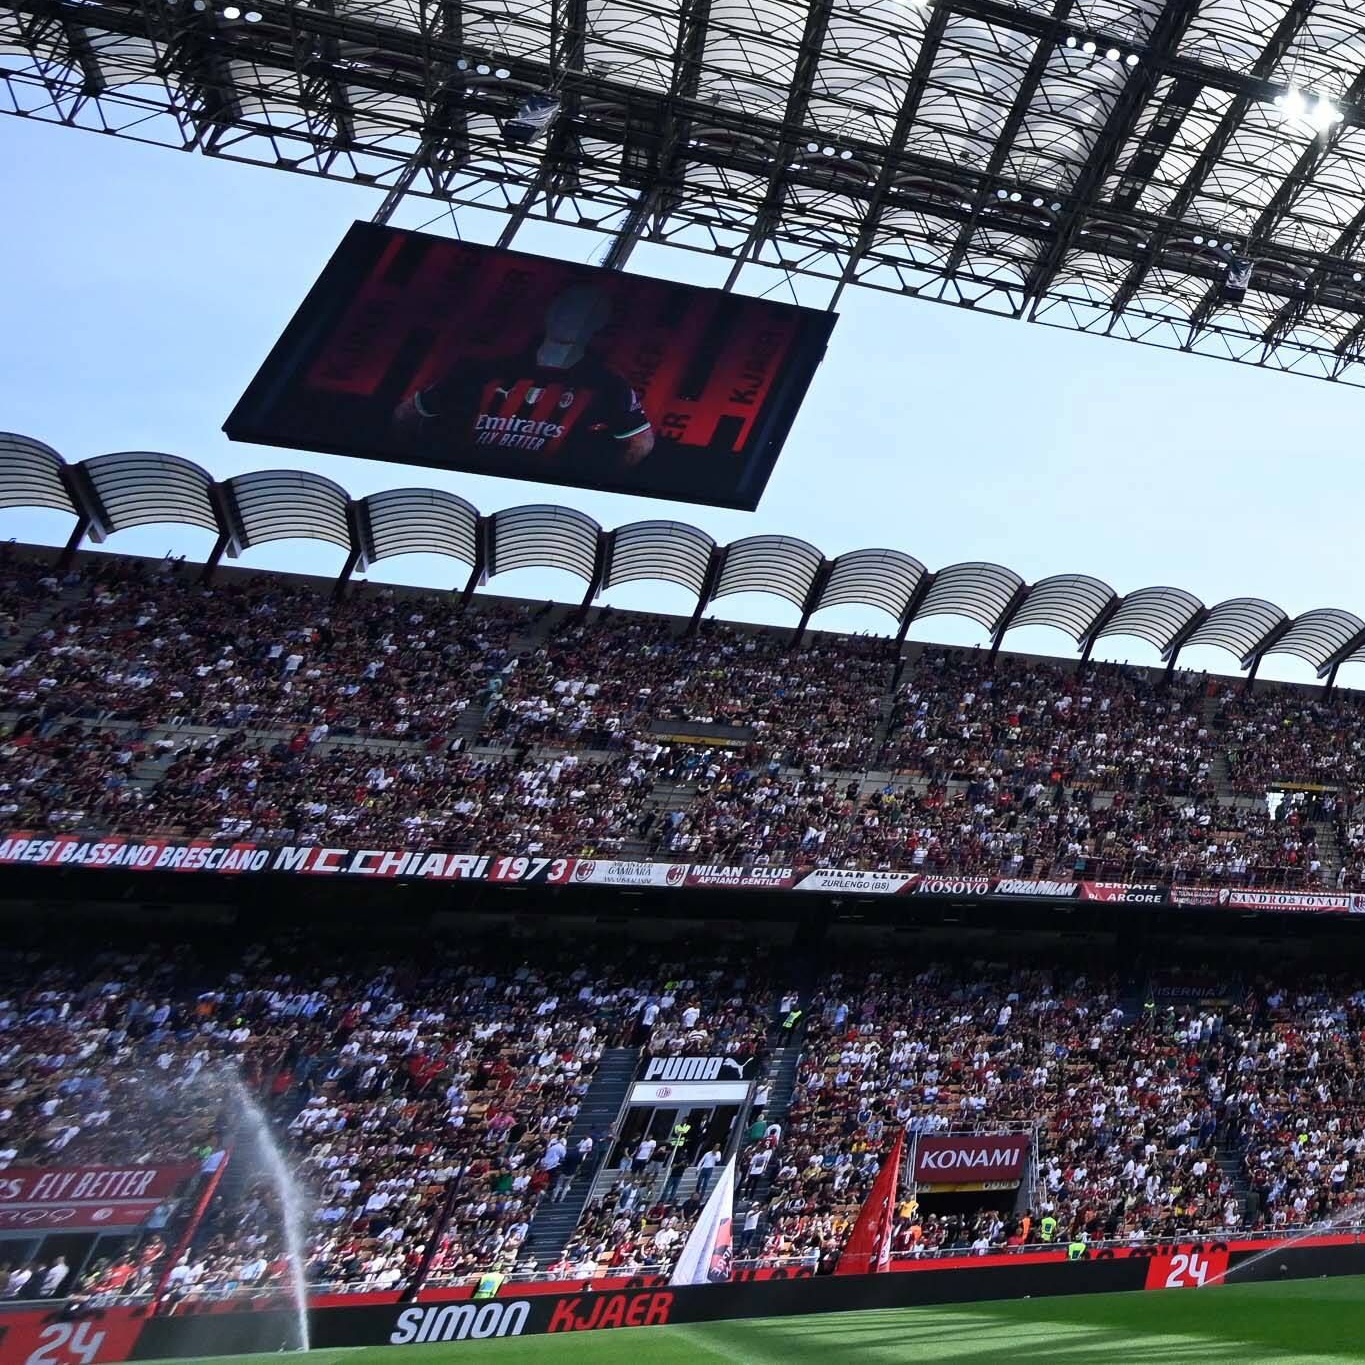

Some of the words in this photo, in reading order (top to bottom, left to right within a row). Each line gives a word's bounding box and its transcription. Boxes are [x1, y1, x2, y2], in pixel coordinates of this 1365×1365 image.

[473, 413, 566, 438] Emirates
[474, 431, 503, 447] FLY
[504, 434, 547, 453] BETTER
[57, 840, 157, 867] BASSANO
[155, 846, 269, 871] BRESCIANO
[496, 856, 568, 881] 1973
[692, 865, 743, 877] MILAN
[751, 866, 792, 879] CLUB
[698, 877, 740, 885] APPIANO
[741, 878, 781, 886] GENTILE
[821, 880, 870, 890] ZURLENGO
[914, 880, 988, 895] KOSOVO
[1107, 893, 1162, 904] ARCORE
[1231, 893, 1287, 904] SANDRO
[1298, 896, 1349, 907] TONALI
[643, 1056, 724, 1081] PUMA
[920, 1147, 1021, 1170] KONAMI
[28, 1172, 79, 1200] FLY
[71, 1170, 157, 1198] BETTER
[1165, 1253, 1209, 1289] 24
[390, 1299, 532, 1346] SIMON
[547, 1291, 674, 1333] KJAER
[24, 1321, 107, 1365] 24
